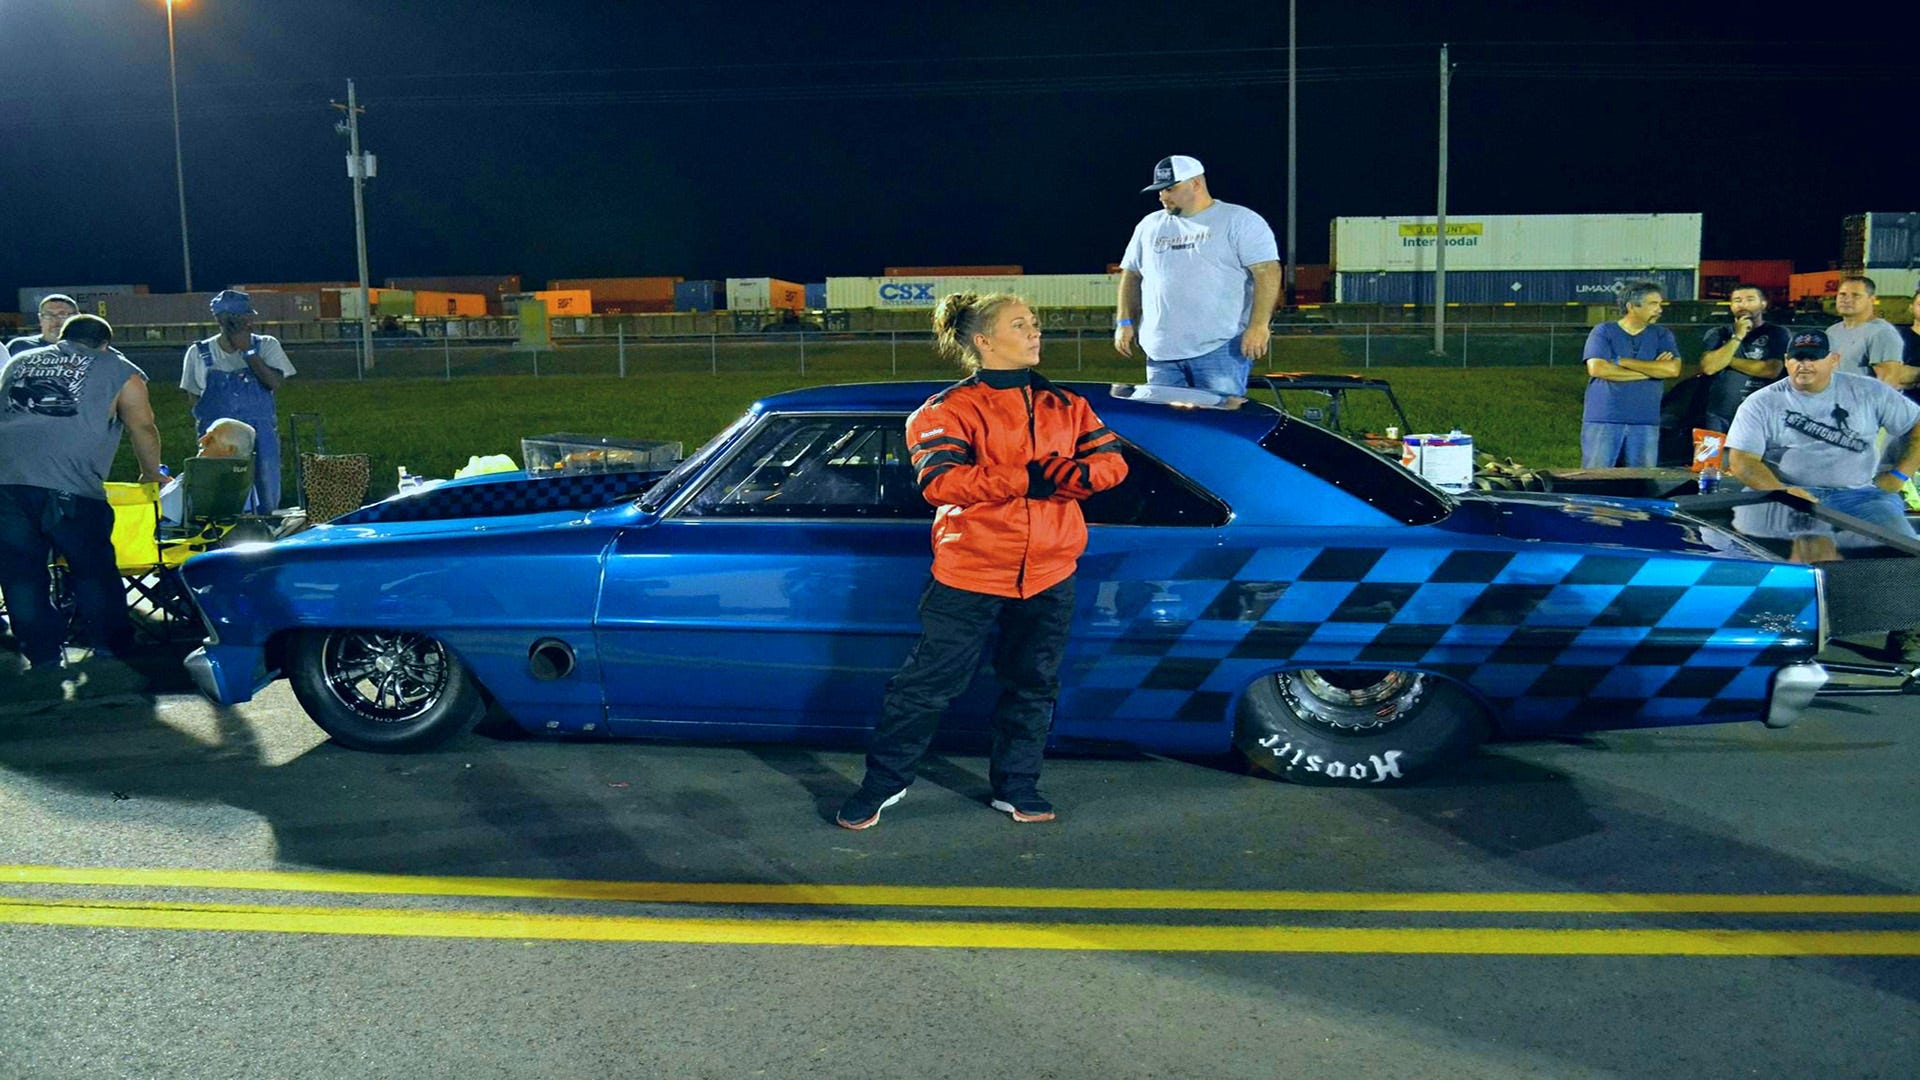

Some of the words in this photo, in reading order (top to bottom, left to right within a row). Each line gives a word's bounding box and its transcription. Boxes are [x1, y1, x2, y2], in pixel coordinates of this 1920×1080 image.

[879, 283, 935, 300] CSX
[27, 353, 88, 367] Bounty
[17, 364, 85, 379] Hunter
[1258, 734, 1404, 783] Hoosier
